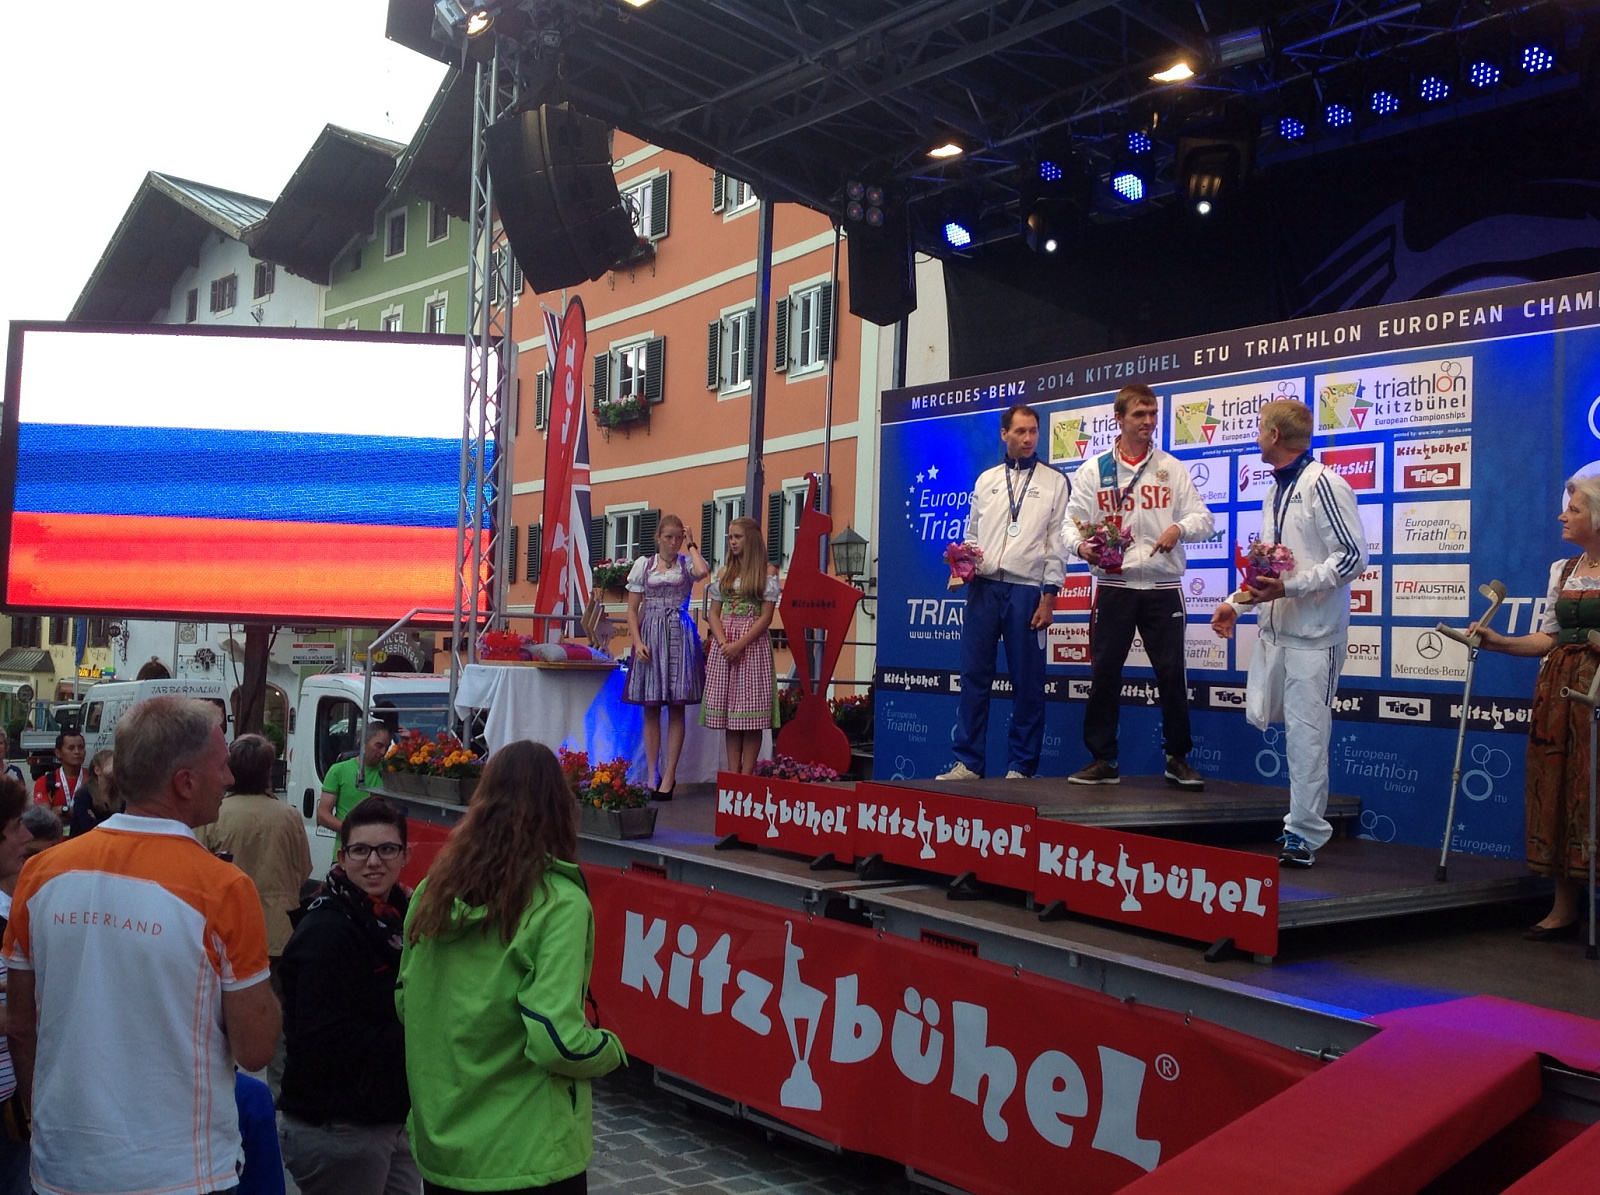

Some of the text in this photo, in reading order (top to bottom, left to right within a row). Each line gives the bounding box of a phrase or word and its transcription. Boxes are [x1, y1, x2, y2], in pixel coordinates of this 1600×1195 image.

[911, 290, 1600, 410] MERCEDES-BENZ 2014 KITZBÜHEL ETU TRIATHLON EUROPEAN CHAM
[1374, 372, 1466, 400] triathlon
[1375, 394, 1467, 416] kitzbühel
[1375, 410, 1466, 427] European Championships
[1318, 422, 1335, 431] 2014
[1410, 467, 1454, 484] Tirol
[920, 489, 975, 510] Europe
[1405, 518, 1450, 528] European
[1405, 528, 1468, 541] Triathlon
[1438, 542, 1465, 550] Union
[910, 630, 961, 640] www.triath
[1202, 660, 1224, 668] Union
[1394, 664, 1466, 676] Mercedes-Benz
[886, 709, 918, 720] European
[1386, 702, 1424, 716] Tirol
[886, 718, 928, 734] Triathlon
[1344, 746, 1398, 762] European
[1344, 759, 1419, 782] Triathlon
[1384, 780, 1416, 794] Union
[1451, 835, 1511, 854] European
